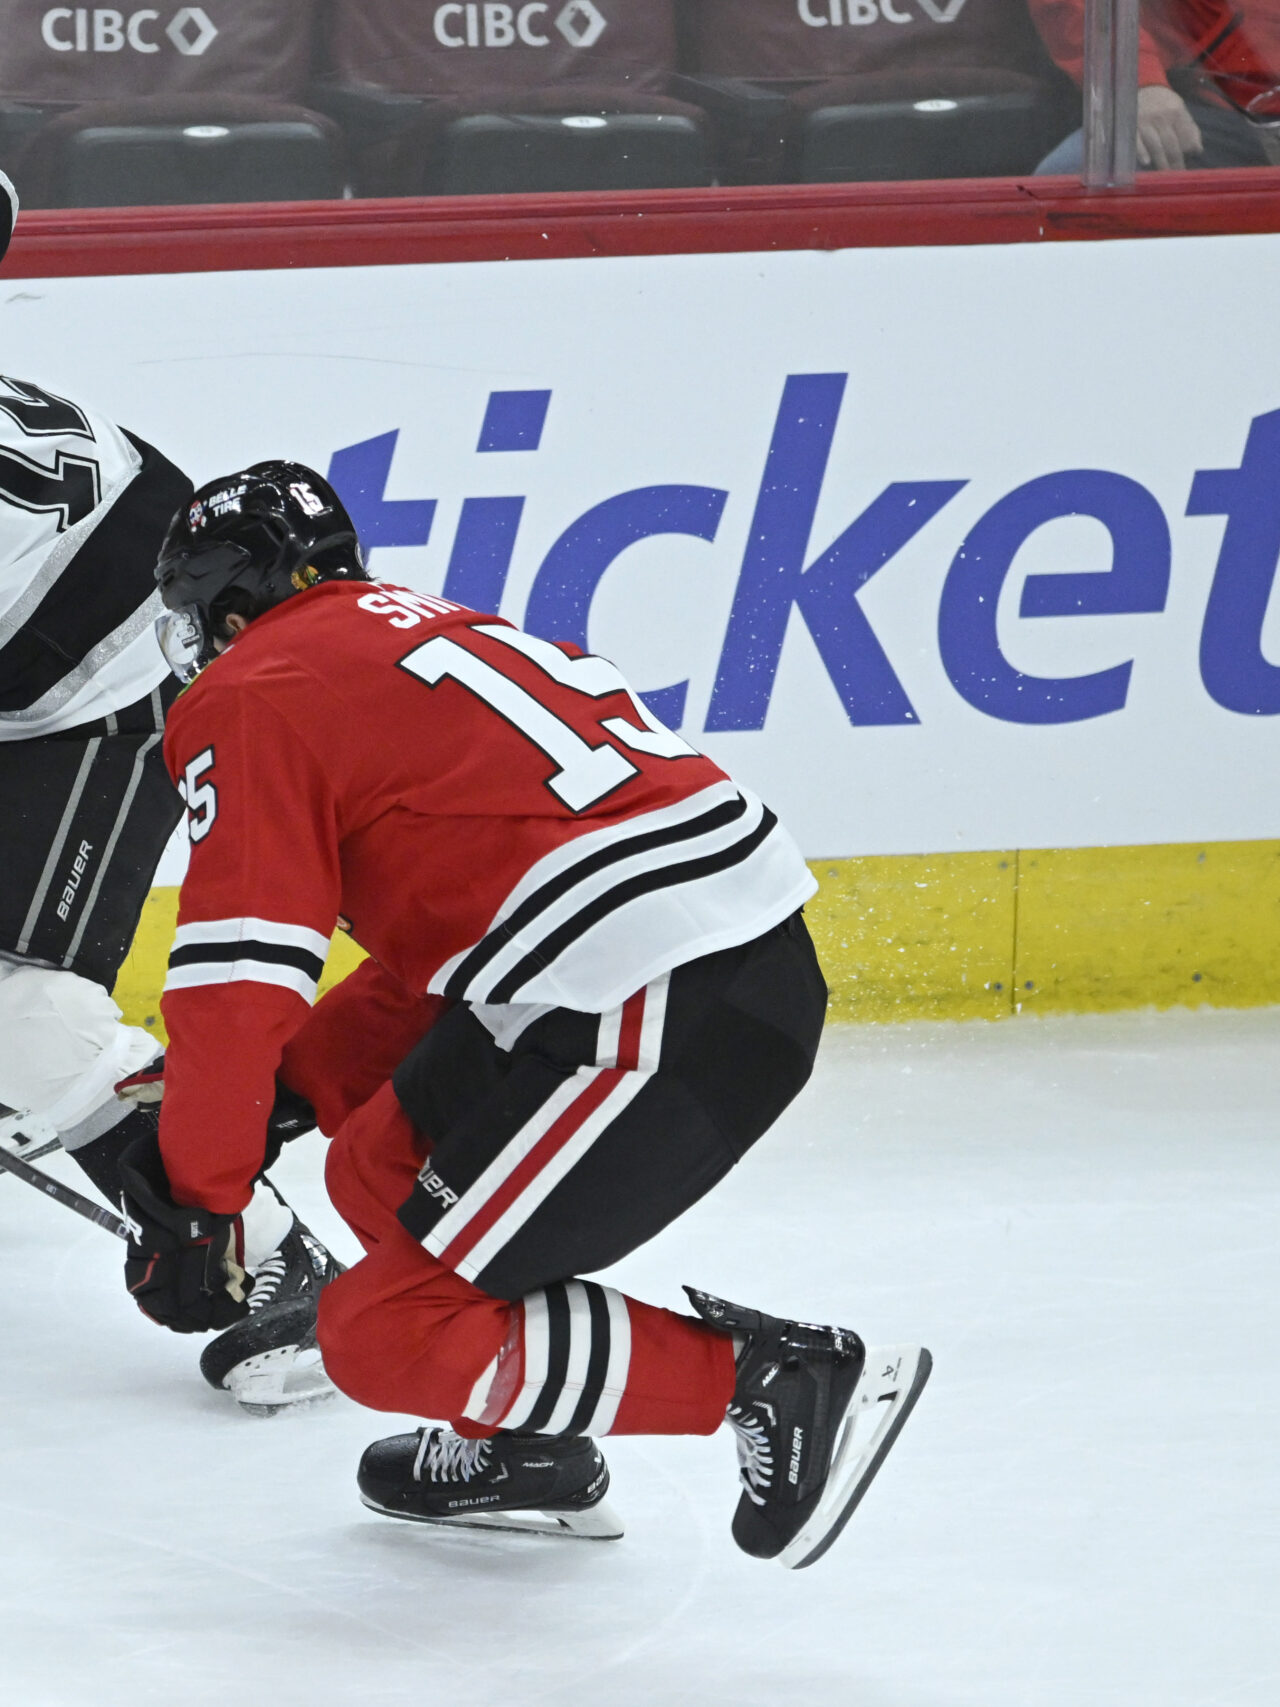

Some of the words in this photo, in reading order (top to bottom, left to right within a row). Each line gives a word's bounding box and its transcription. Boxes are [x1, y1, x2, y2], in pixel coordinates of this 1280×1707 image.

[41, 8, 160, 54] CIBC
[433, 2, 550, 48] CIBC
[797, 0, 914, 28] CIBC
[208, 484, 247, 508] BELLE
[212, 497, 242, 517] TIRE
[289, 482, 325, 516] 15
[357, 587, 477, 630] SMI
[394, 623, 705, 816] 15
